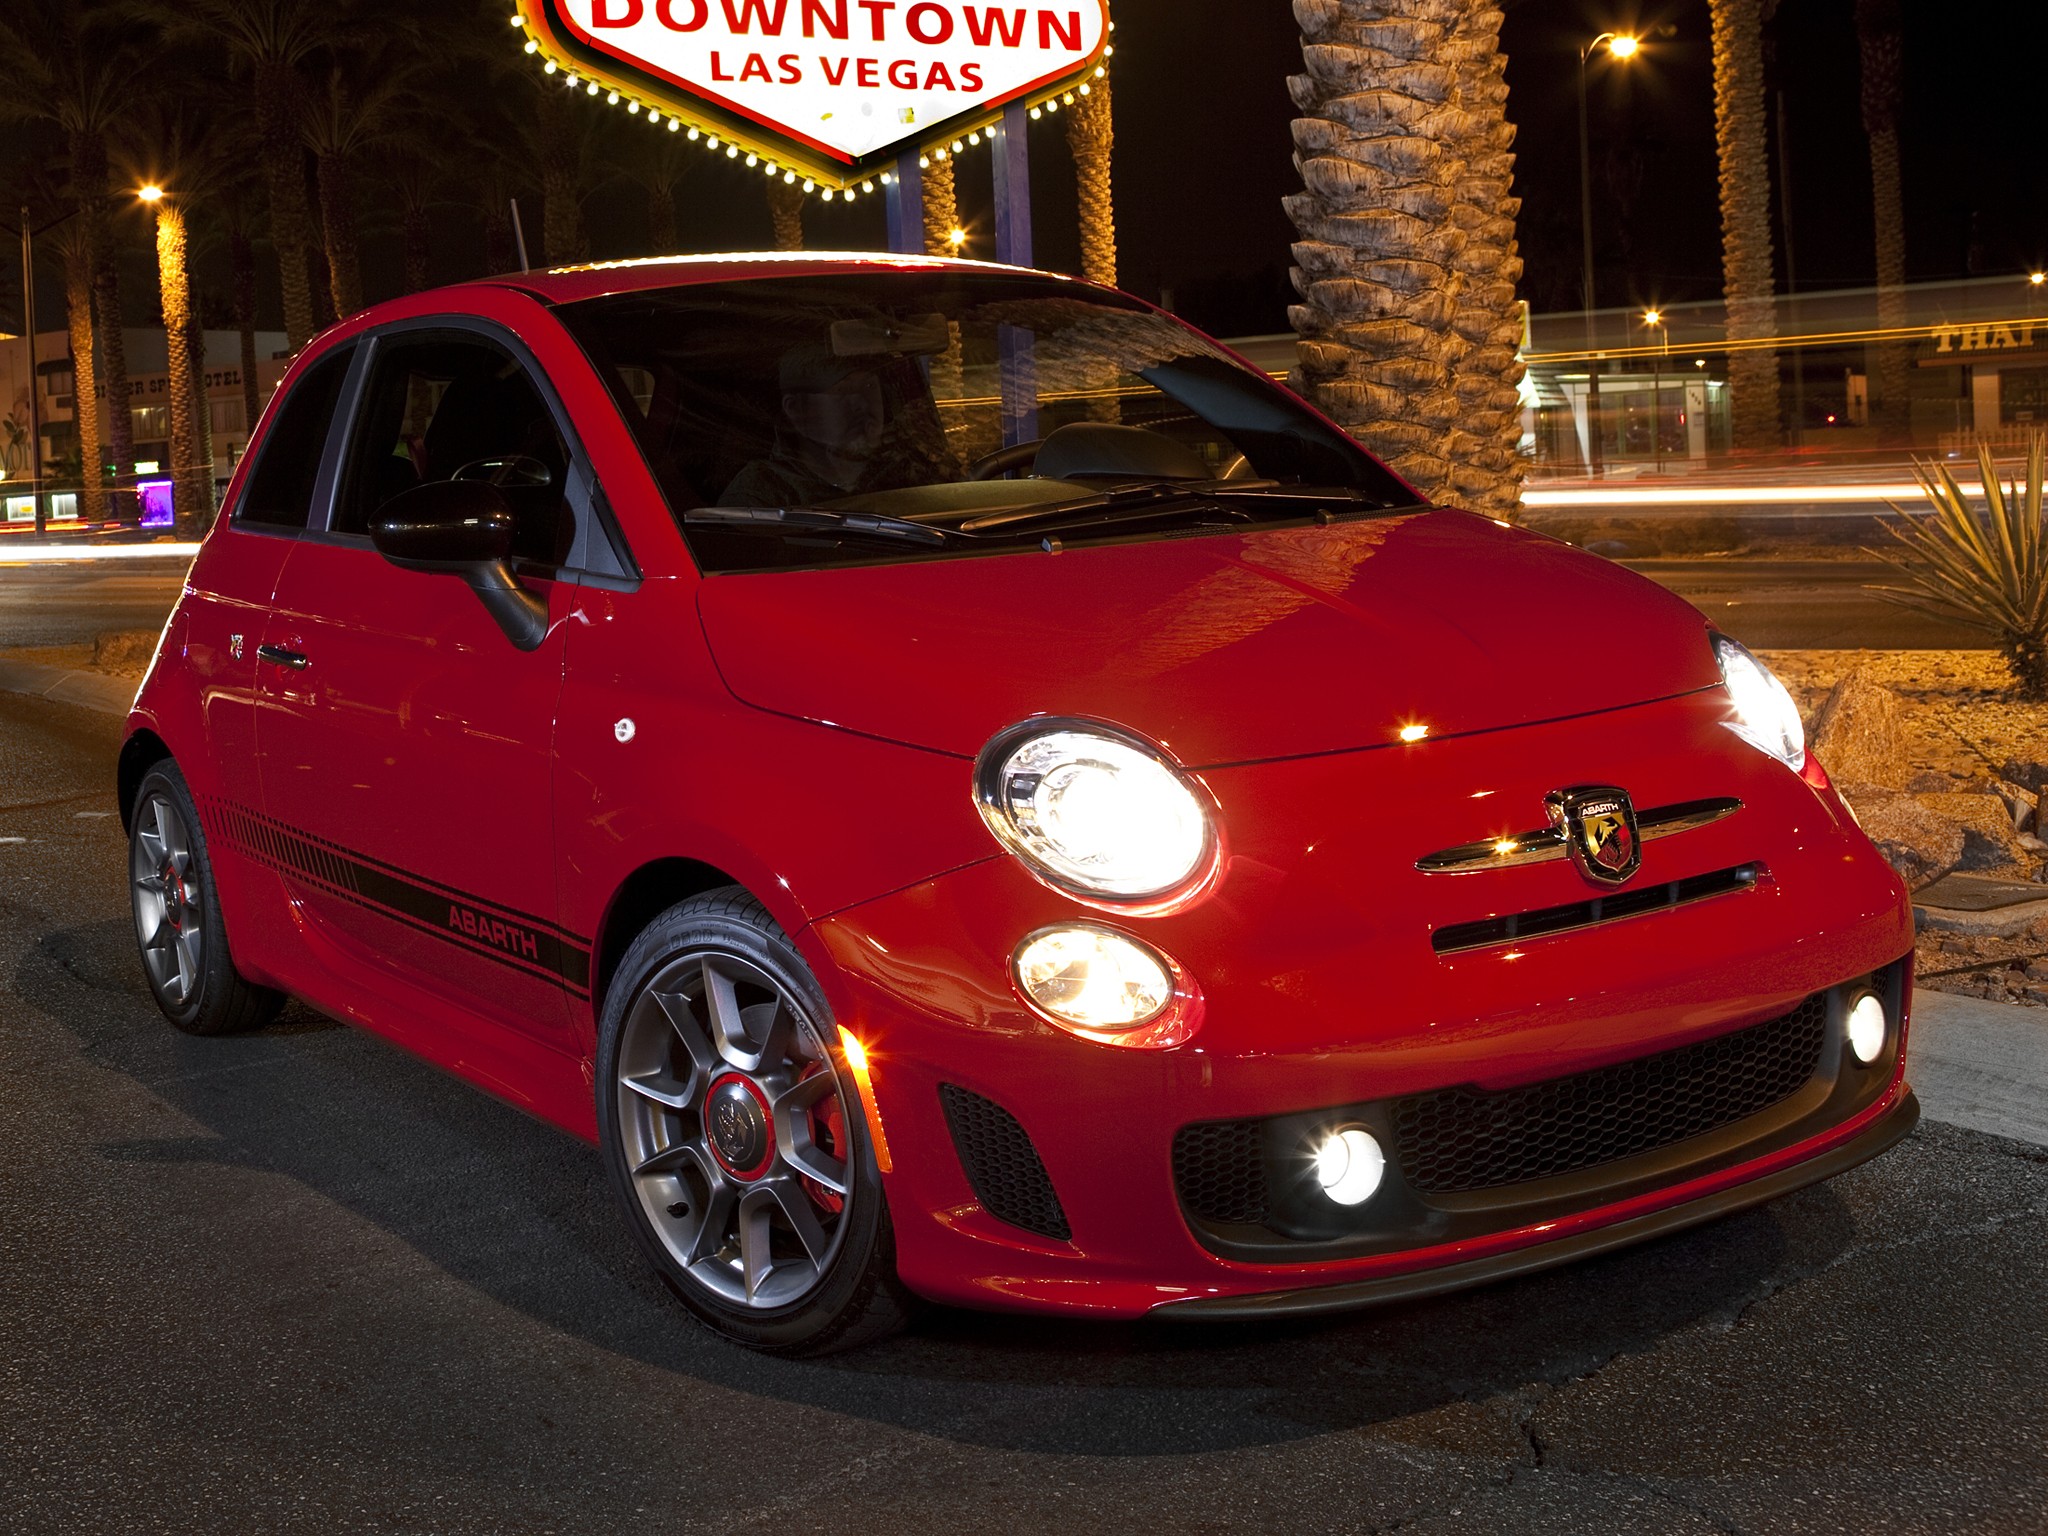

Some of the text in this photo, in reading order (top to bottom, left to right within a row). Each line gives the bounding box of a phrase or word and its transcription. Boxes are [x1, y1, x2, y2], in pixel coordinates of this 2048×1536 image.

[591, 0, 1082, 51] DOWNTOWN
[710, 50, 984, 93] LAS VEGAS
[1932, 322, 2034, 352] THAI
[94, 380, 145, 399] SIER
[199, 370, 242, 388] OTEL
[1582, 803, 1619, 816] ABARTH
[449, 905, 538, 960] ABARTH
